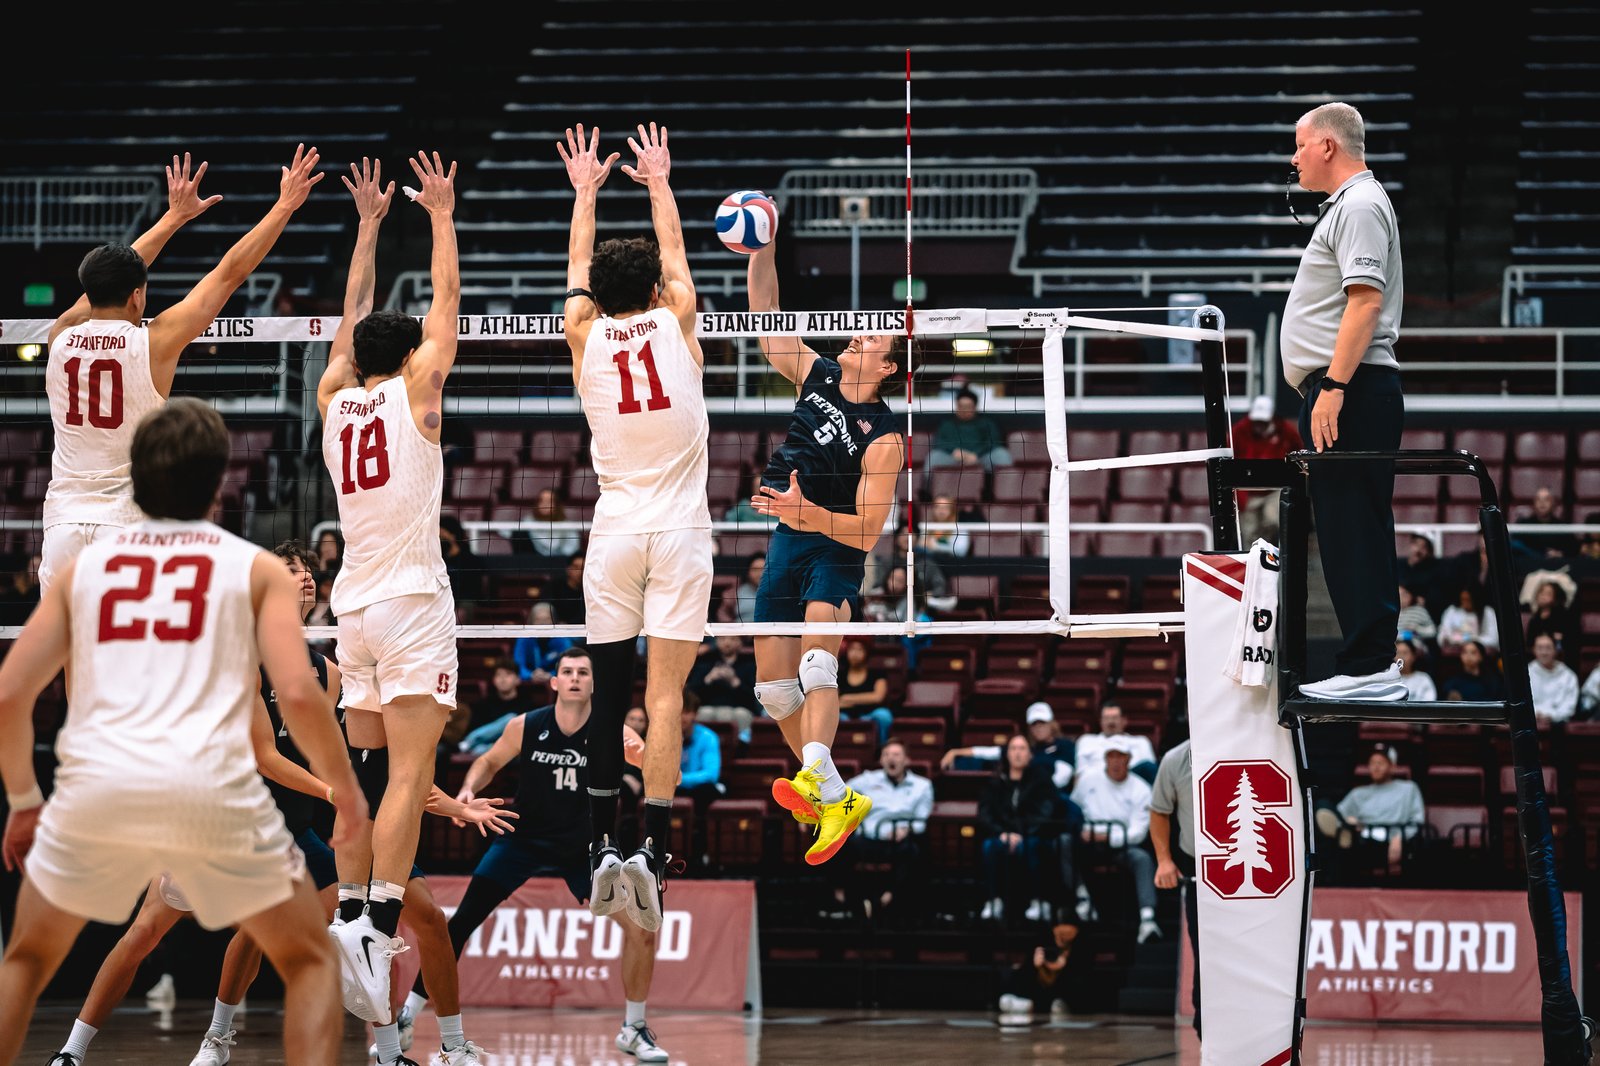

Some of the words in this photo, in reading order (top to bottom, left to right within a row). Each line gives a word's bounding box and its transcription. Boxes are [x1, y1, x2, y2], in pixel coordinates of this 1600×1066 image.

[480, 315, 565, 335] ATHLETIC
[703, 313, 796, 332] STANFORD
[806, 311, 905, 331] ATHLETICS
[66, 333, 126, 351] STANFORD
[612, 339, 671, 415] 11
[63, 356, 124, 430] 10
[339, 391, 386, 418] STANOD
[804, 391, 858, 456] PEPPERDINE
[813, 420, 838, 446] 5
[339, 415, 391, 495] 18
[98, 553, 214, 644] 23
[552, 766, 579, 792] 14
[1307, 919, 1517, 973] ANFORD
[498, 964, 610, 981] ATHLETICS
[1317, 976, 1435, 993] ATHLETICS
